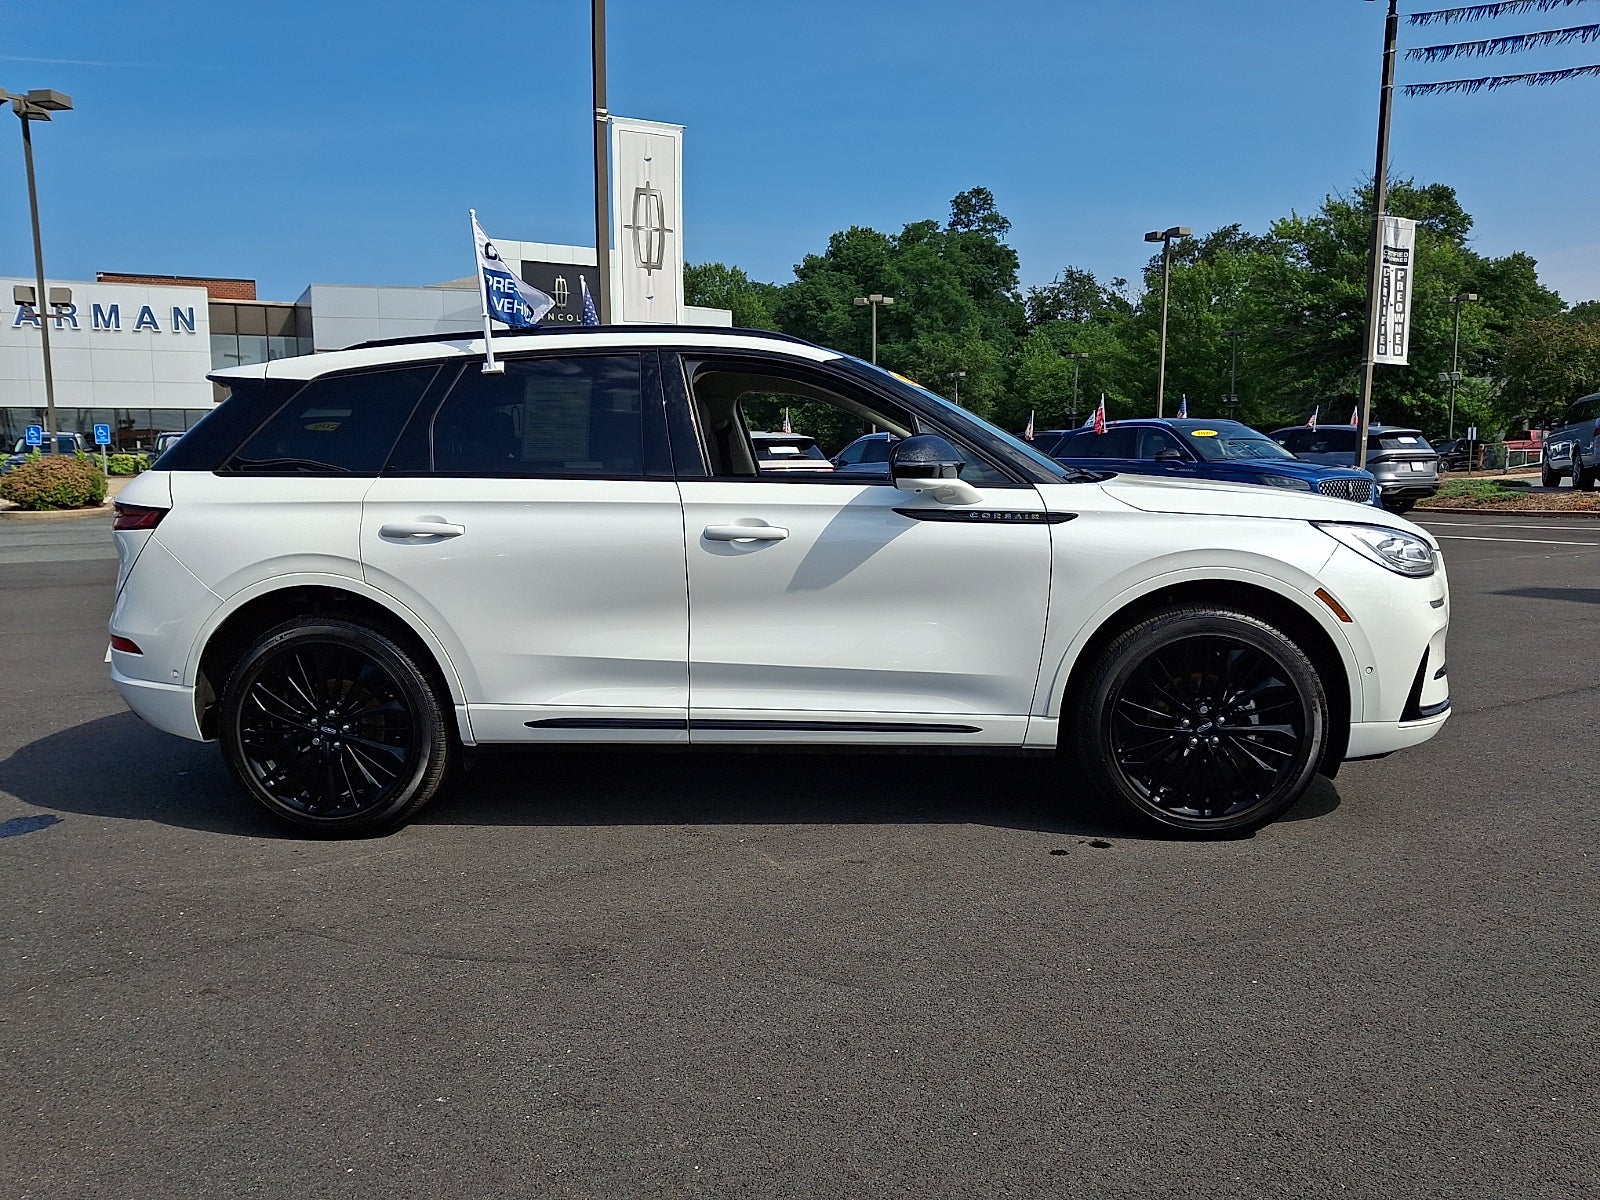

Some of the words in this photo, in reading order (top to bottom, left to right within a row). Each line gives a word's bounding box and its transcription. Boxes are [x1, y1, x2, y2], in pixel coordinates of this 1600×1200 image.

[541, 312, 582, 323] NCOL
[1379, 267, 1390, 354] CERTIFIED
[1394, 270, 1404, 355] PREOWNED
[969, 511, 1040, 520] CORSAIR
